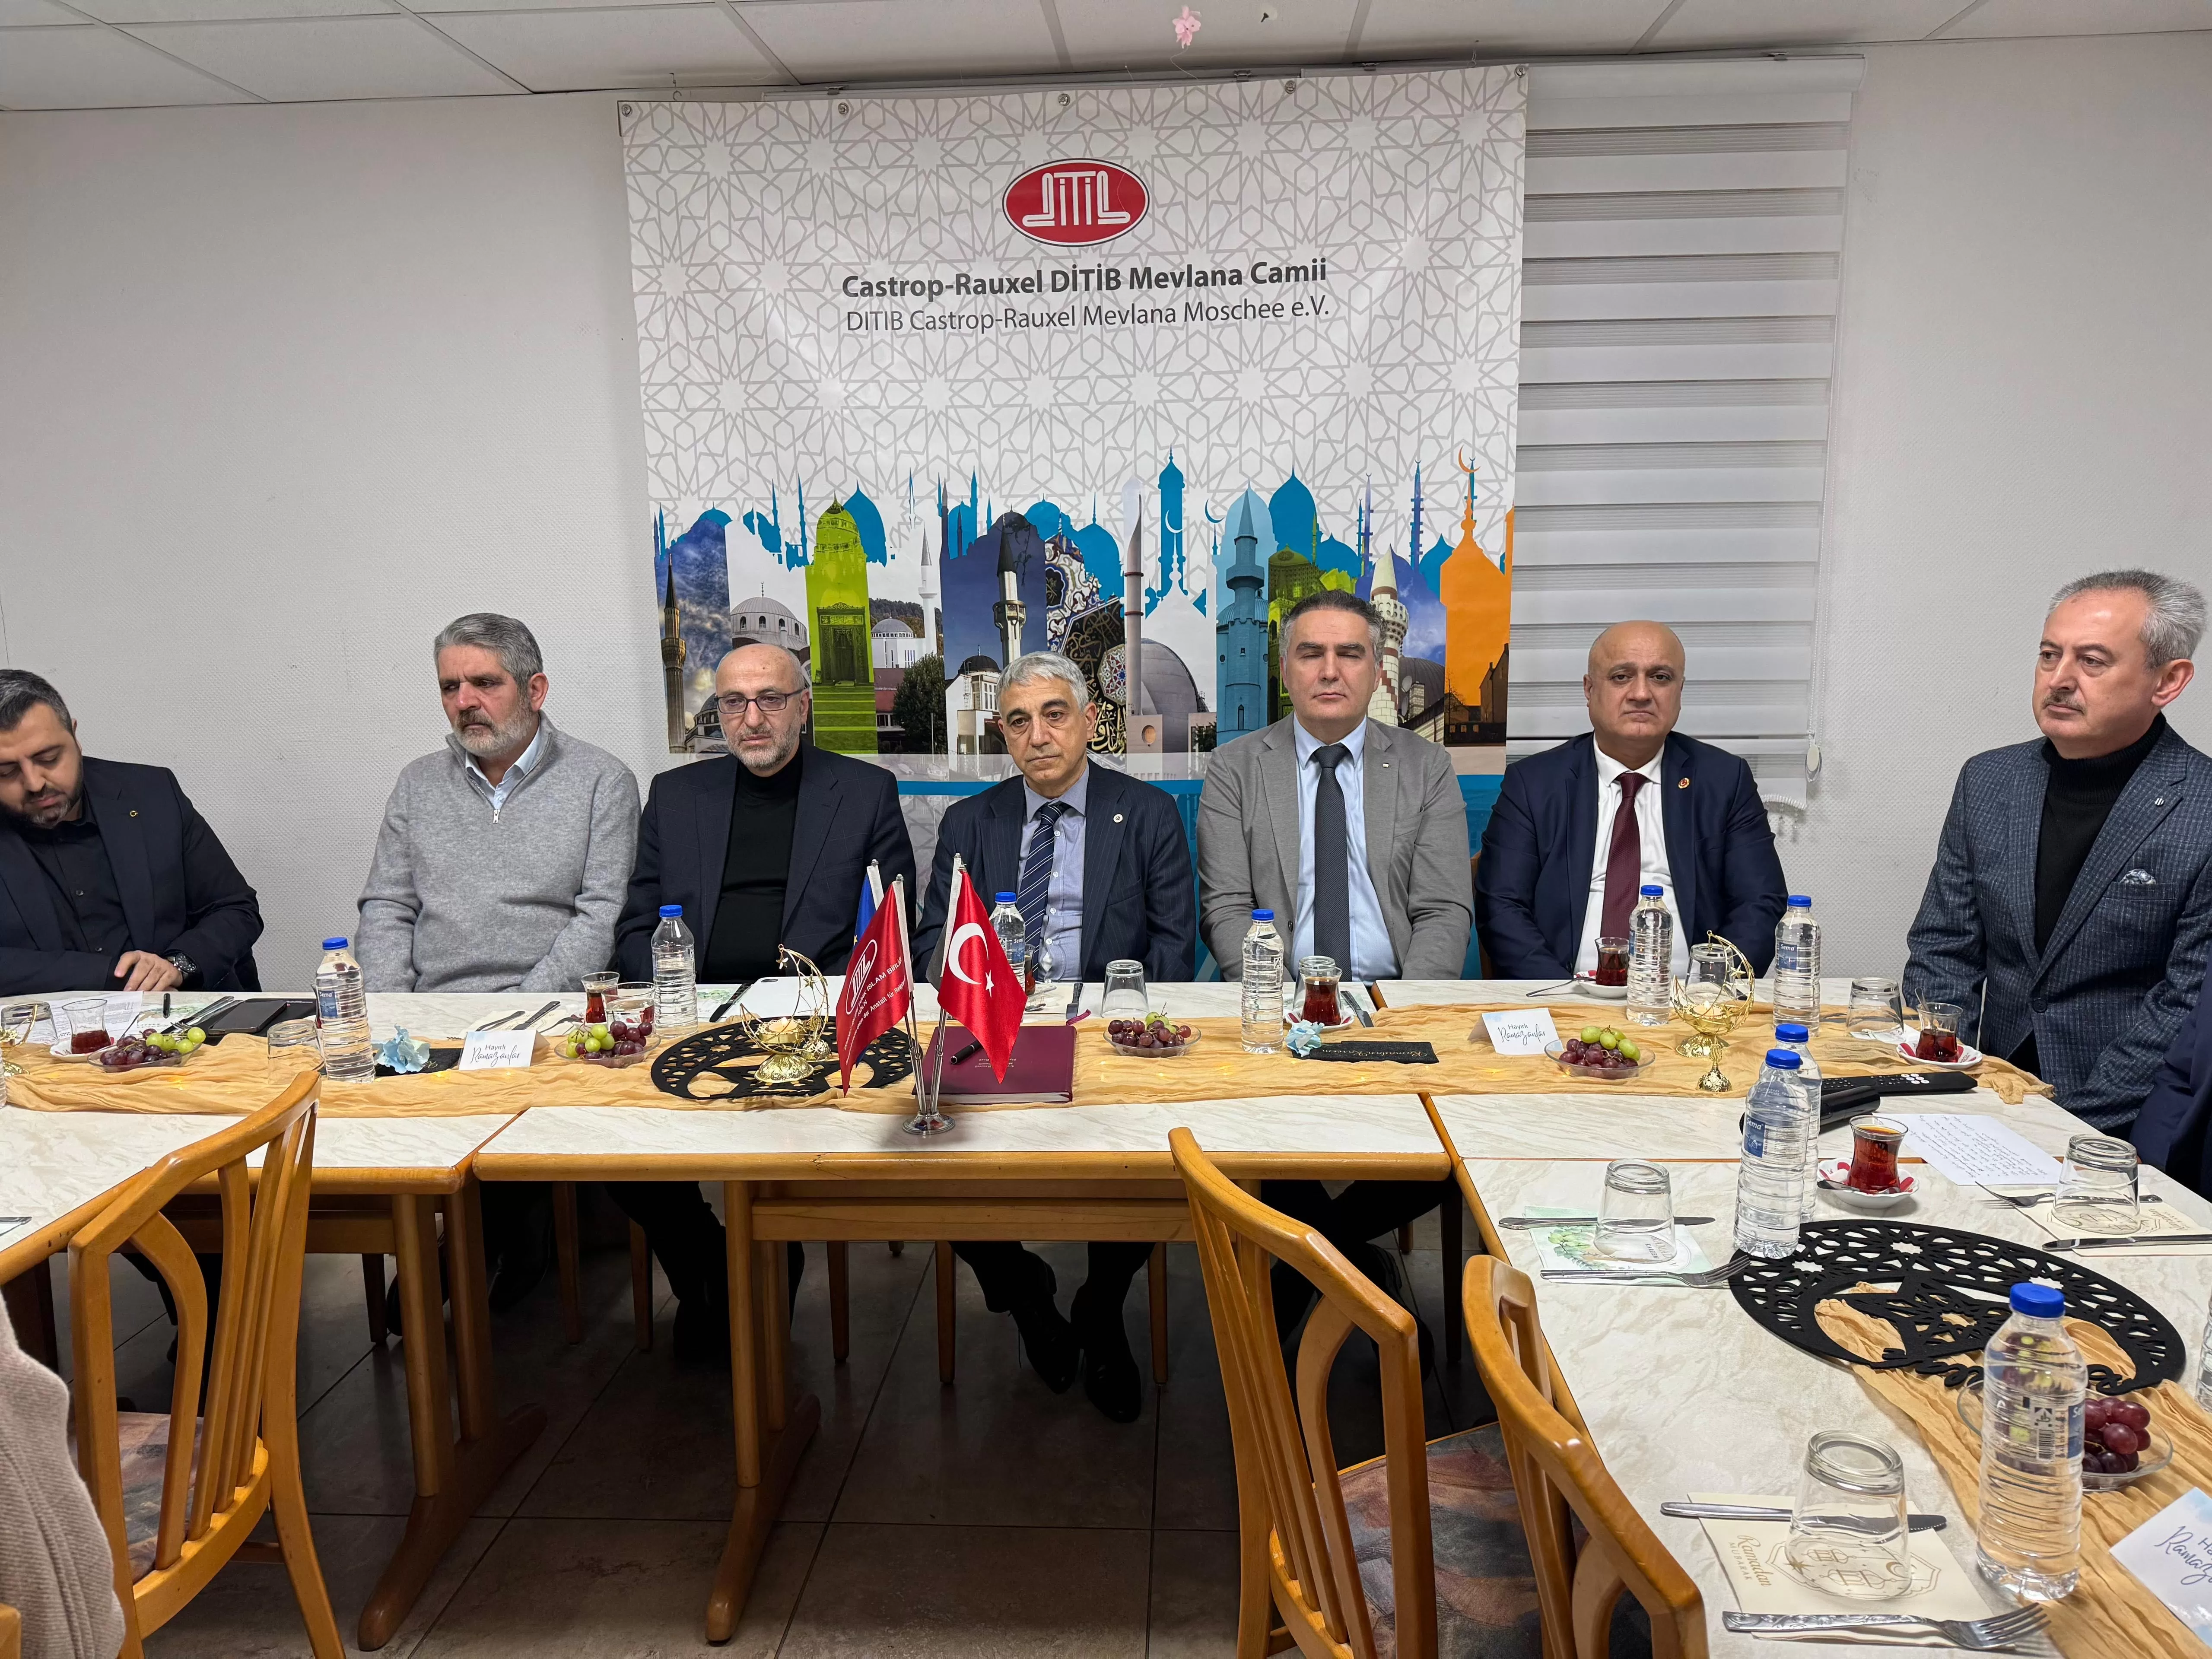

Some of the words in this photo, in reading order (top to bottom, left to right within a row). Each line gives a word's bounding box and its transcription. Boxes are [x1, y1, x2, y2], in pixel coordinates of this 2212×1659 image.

[842, 269, 1042, 302] Castrop-Rauxel
[1051, 264, 1122, 293] DİTİB
[1129, 264, 1242, 289] Mevlana
[1251, 258, 1326, 284] Camii
[847, 311, 903, 331] DITIB
[910, 305, 1075, 334] Castrop-Rauxel
[1084, 303, 1176, 326] Mevlana
[1184, 299, 1284, 322] Moschee
[1292, 295, 1329, 317] e.V.
[870, 996, 887, 1012] Anstalt
[1497, 1023, 1545, 1046] Ramazanlar
[470, 1045, 520, 1068] Ramazanlar
[1747, 1117, 1762, 1130] Sema
[1728, 1541, 1753, 1580] MUBARAK
[1737, 1535, 1773, 1587] Ramadan
